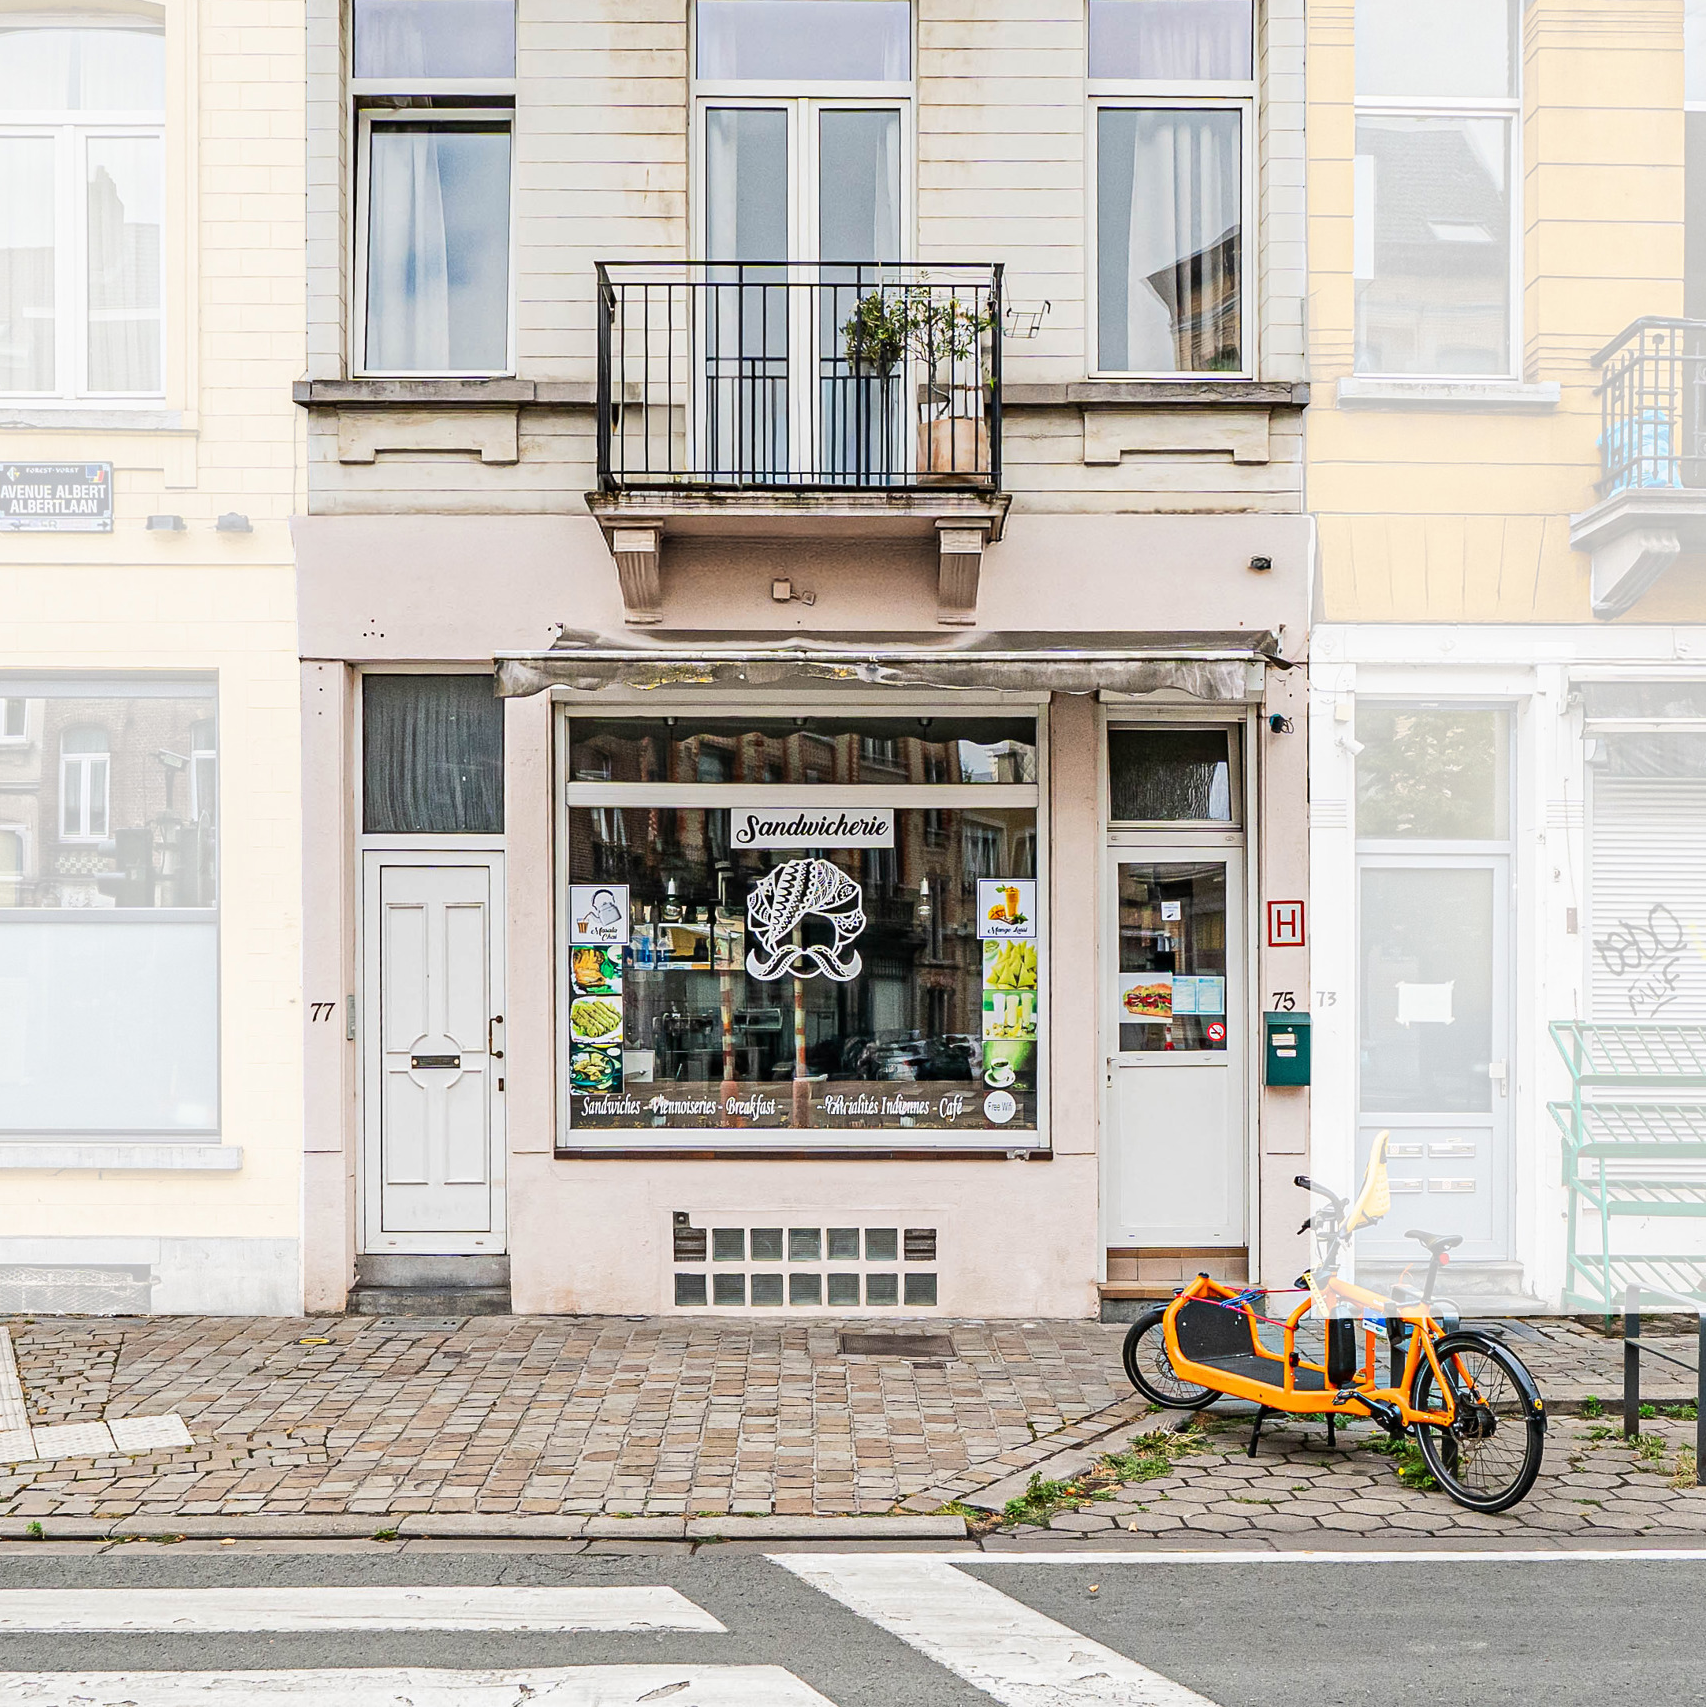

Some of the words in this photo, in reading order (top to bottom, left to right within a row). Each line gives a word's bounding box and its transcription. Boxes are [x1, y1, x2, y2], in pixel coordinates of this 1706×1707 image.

[0, 484, 52, 499] AVENUE
[56, 484, 106, 499] ALBERT
[10, 499, 98, 513] ALBERTLAAN
[736, 813, 889, 844] Sandwicherie
[1276, 909, 1296, 938] H
[1271, 991, 1296, 1012] 75
[1315, 990, 1338, 1007] 73
[310, 1002, 336, 1022] 77
[581, 1093, 641, 1117] Sandwiches
[651, 1094, 716, 1115] Viennoiseries
[726, 1093, 776, 1121] Breakfast
[881, 1093, 930, 1116] Indiennes
[939, 1094, 964, 1122] Café
[987, 1101, 1000, 1111] Free
